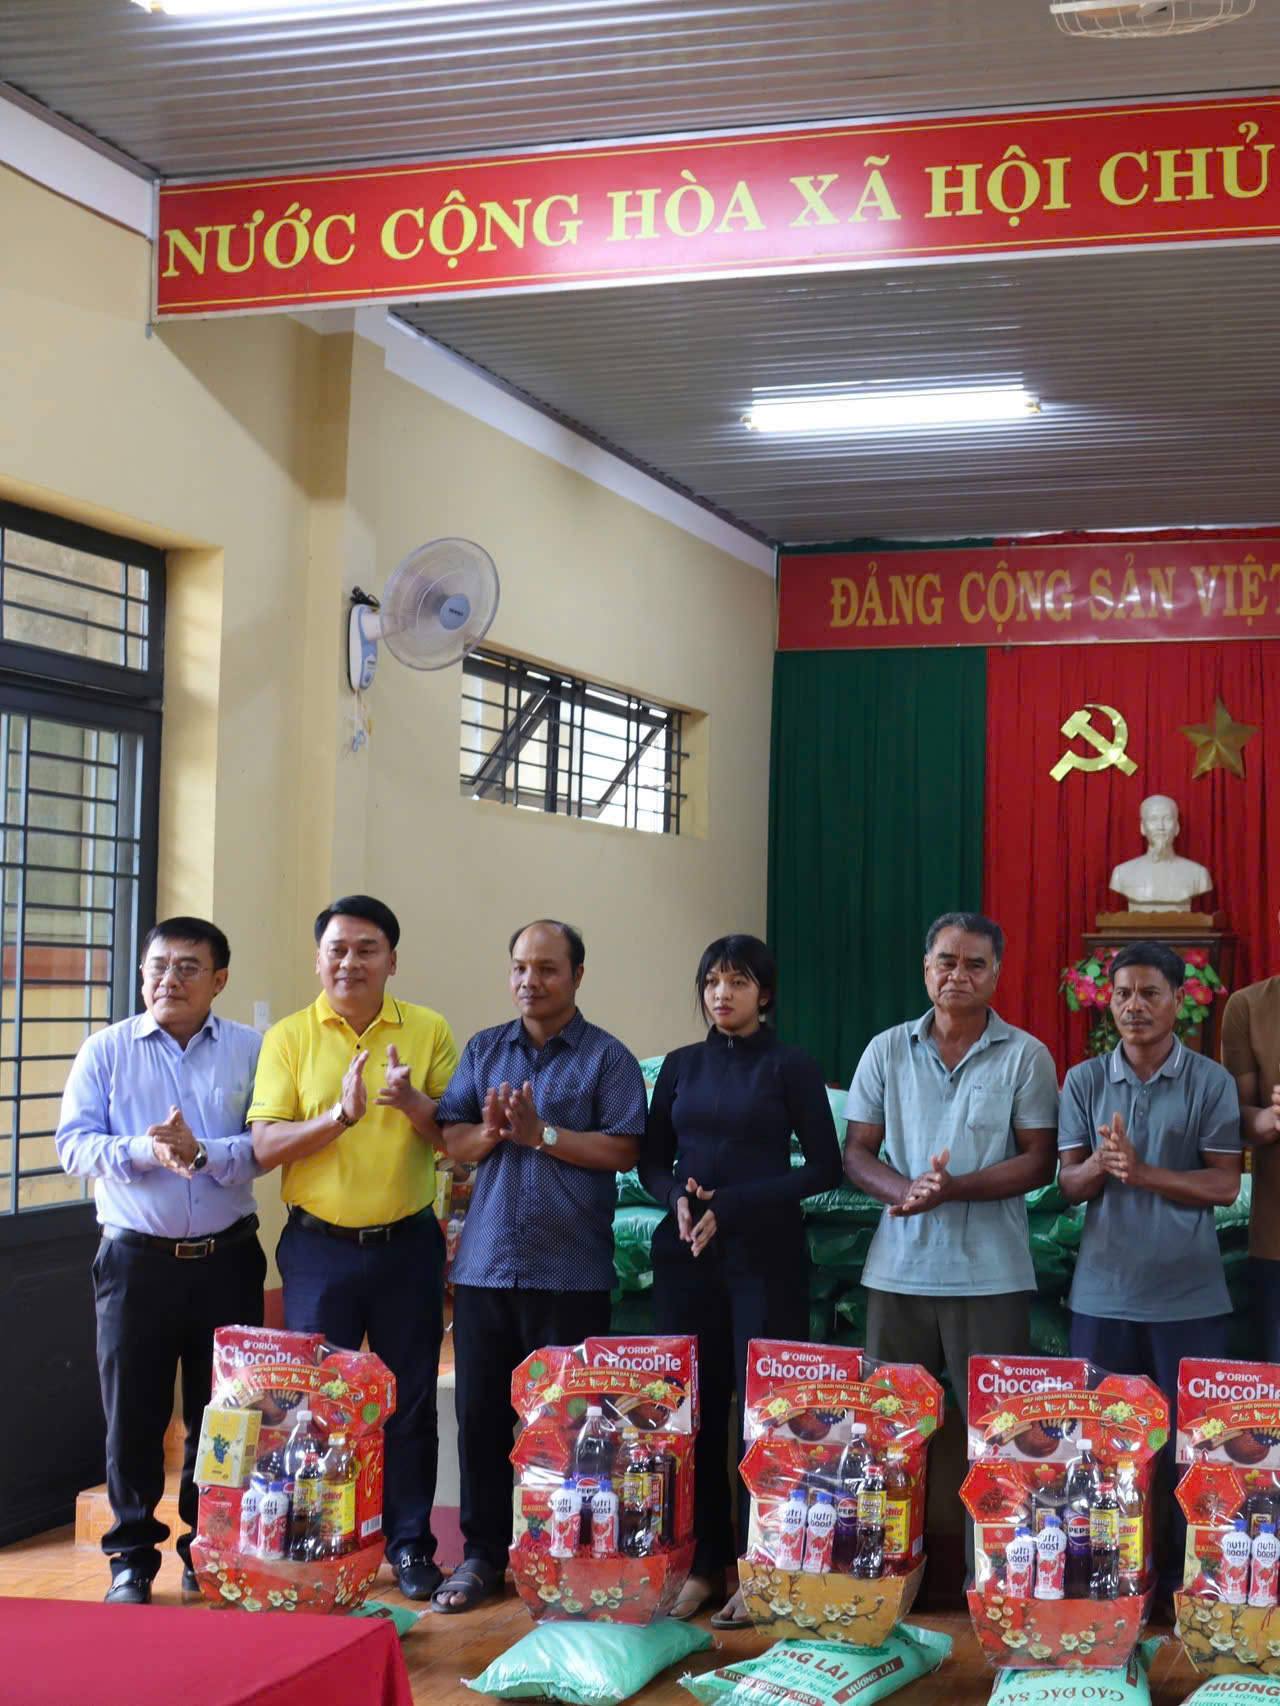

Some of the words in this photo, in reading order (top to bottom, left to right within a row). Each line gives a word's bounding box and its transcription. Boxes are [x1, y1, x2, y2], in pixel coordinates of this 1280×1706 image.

[162, 202, 356, 277] NƯỚC
[381, 188, 582, 269] CỘNG
[606, 169, 767, 242] HÒA
[789, 155, 901, 227] XÃ
[924, 145, 1071, 227] HỘI
[1099, 121, 1275, 206] CHỦ
[830, 562, 944, 628] ĐẢNG
[959, 561, 1071, 633] CỘNG
[1089, 554, 1175, 621] SẢN
[791, 1353, 823, 1363] ORION
[756, 1357, 847, 1381] ChocoPie
[1015, 1367, 1048, 1376] ORION
[1227, 1373, 1260, 1382] ORION
[577, 1486, 600, 1495] PEPS
[838, 1508, 857, 1516] PEPS
[1069, 1527, 1090, 1535] PEPS
[1204, 1680, 1280, 1696] HƯƠNG
